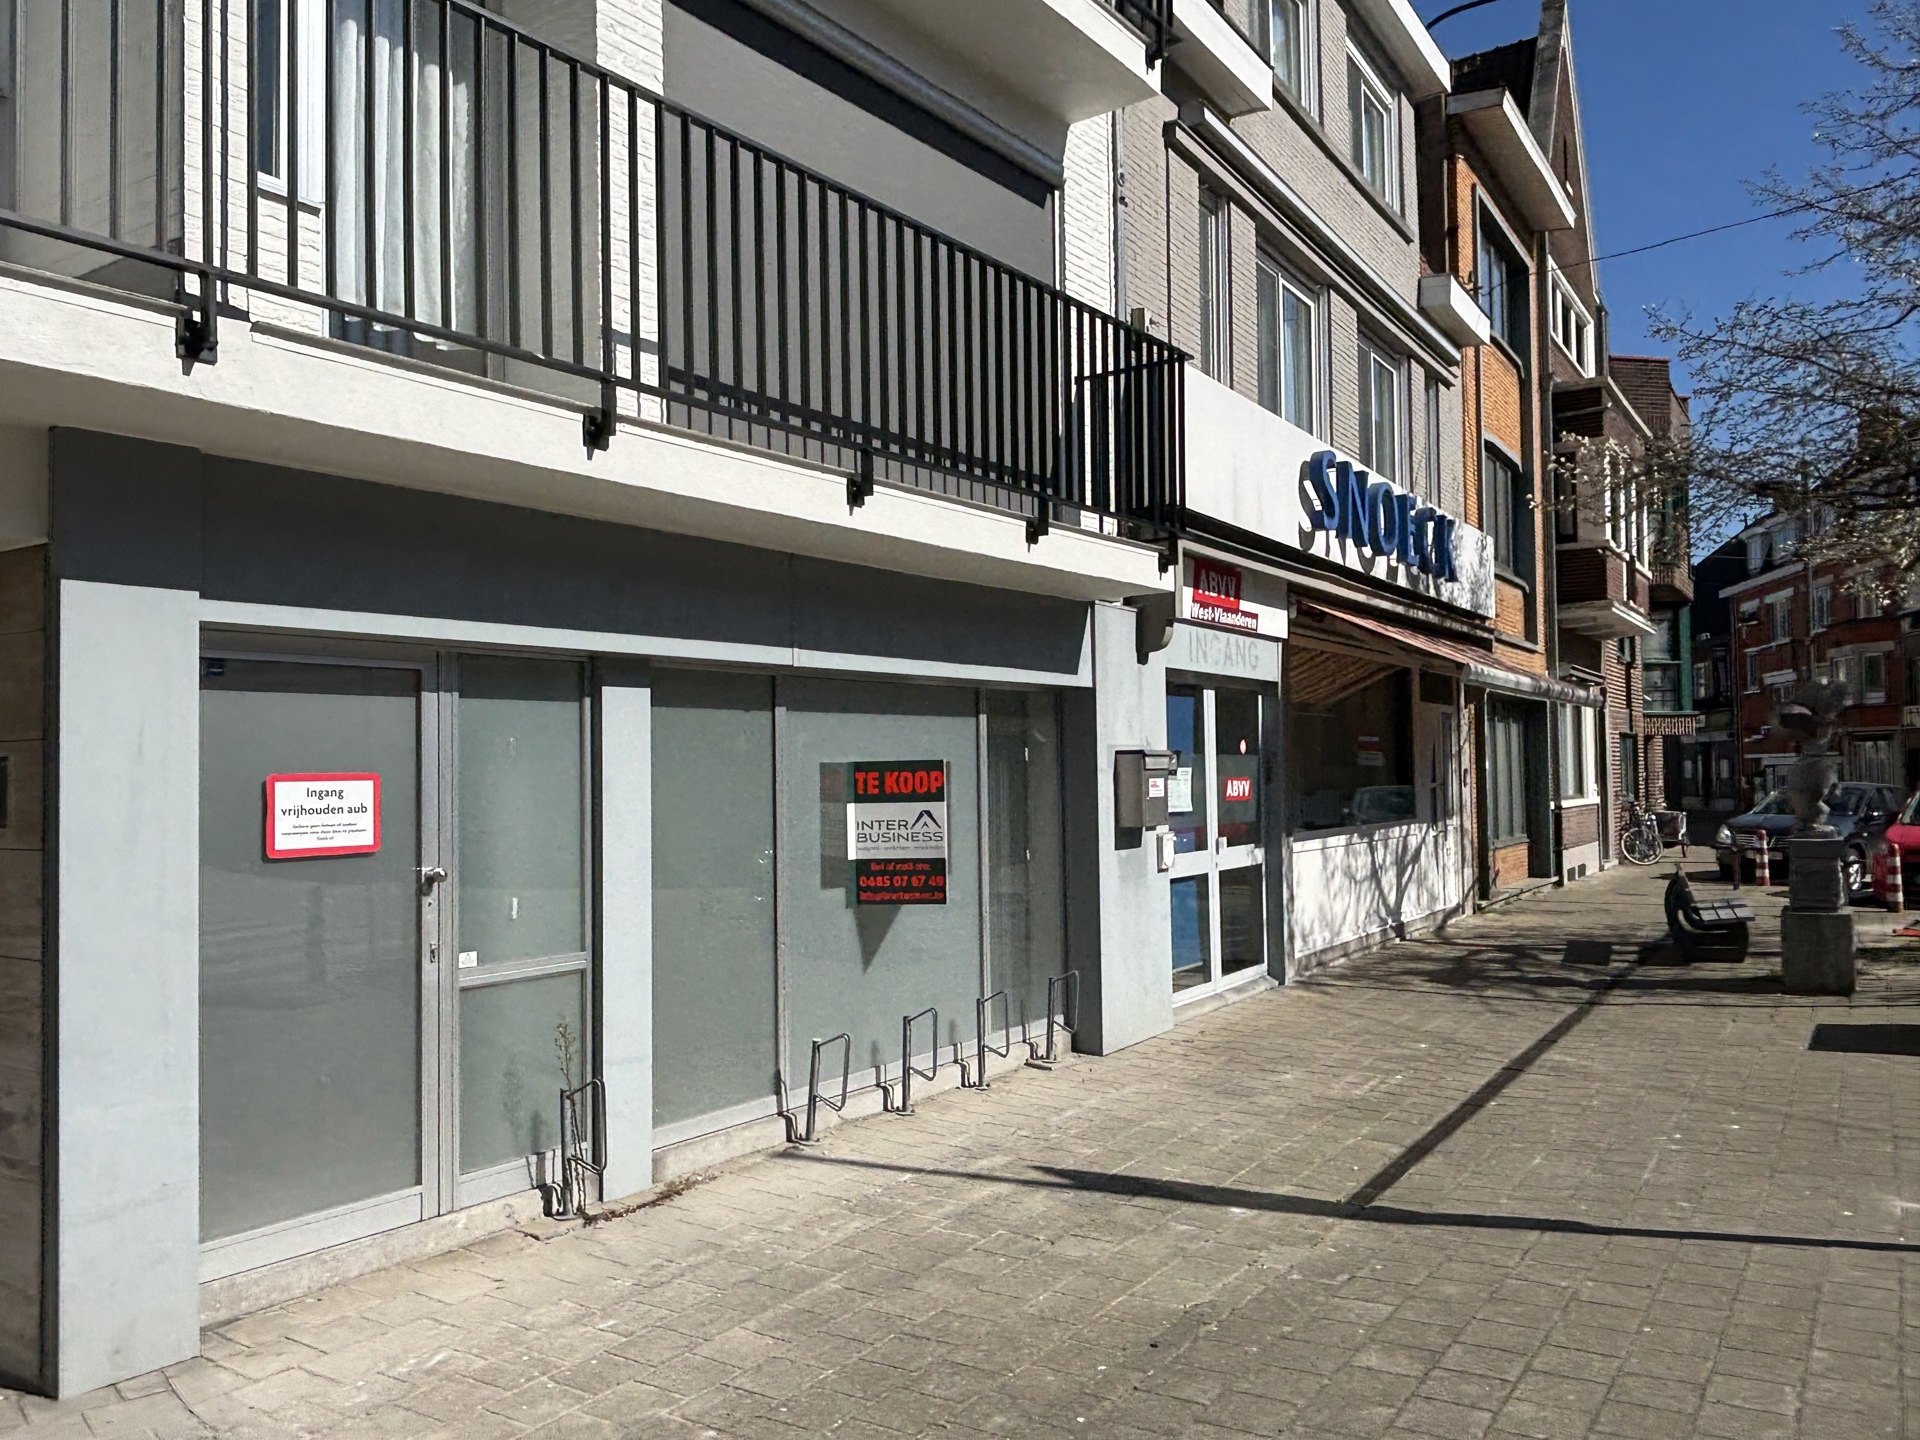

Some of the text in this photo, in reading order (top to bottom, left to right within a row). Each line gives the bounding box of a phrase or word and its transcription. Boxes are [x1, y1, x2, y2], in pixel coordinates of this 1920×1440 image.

[1198, 569, 1237, 601] ABVV
[854, 770, 945, 795] TE KOOP
[1226, 779, 1250, 797] ABVV
[306, 787, 345, 801] Ingang
[281, 802, 368, 819] vrijhouden aub
[856, 819, 909, 831] INTER
[856, 831, 944, 844] BUSINESS
